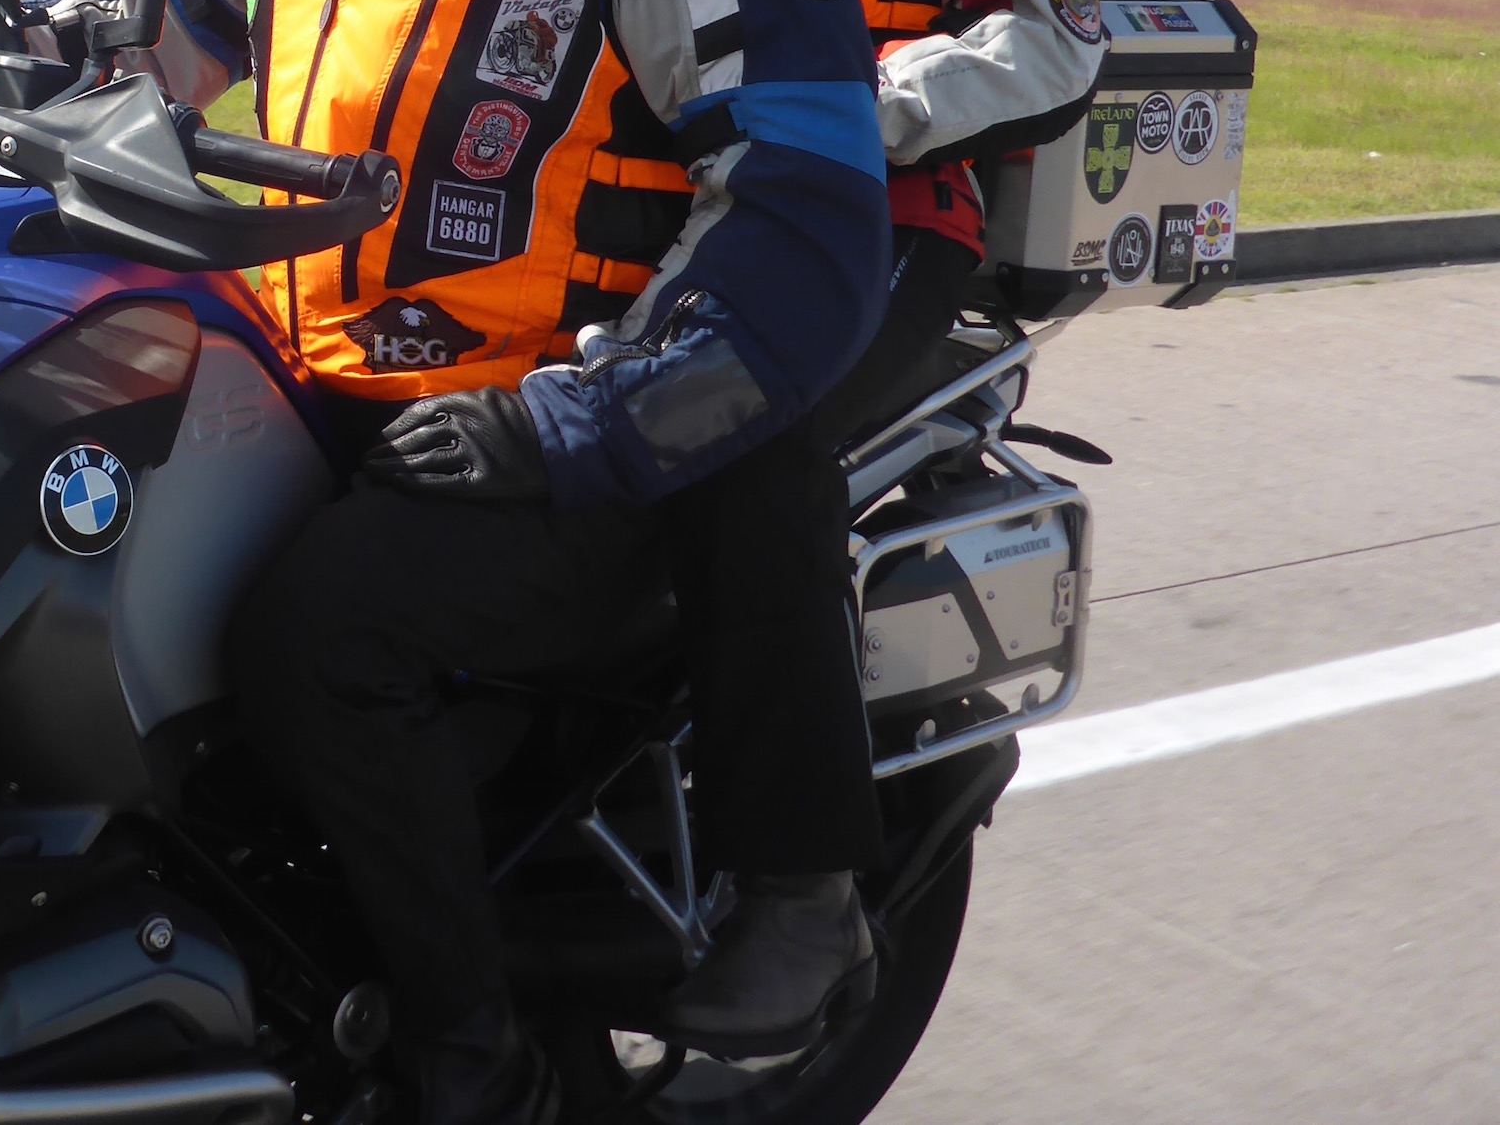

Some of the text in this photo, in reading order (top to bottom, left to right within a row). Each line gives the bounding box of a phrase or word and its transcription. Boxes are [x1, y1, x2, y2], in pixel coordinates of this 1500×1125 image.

[1090, 106, 1136, 122] IRELAND
[1142, 110, 1170, 125] TOWN
[1141, 124, 1169, 138] MOTO
[440, 195, 495, 219] HANGAR
[439, 216, 491, 245] 6880
[1165, 218, 1195, 237] TEXAS
[47, 449, 120, 494] BMW
